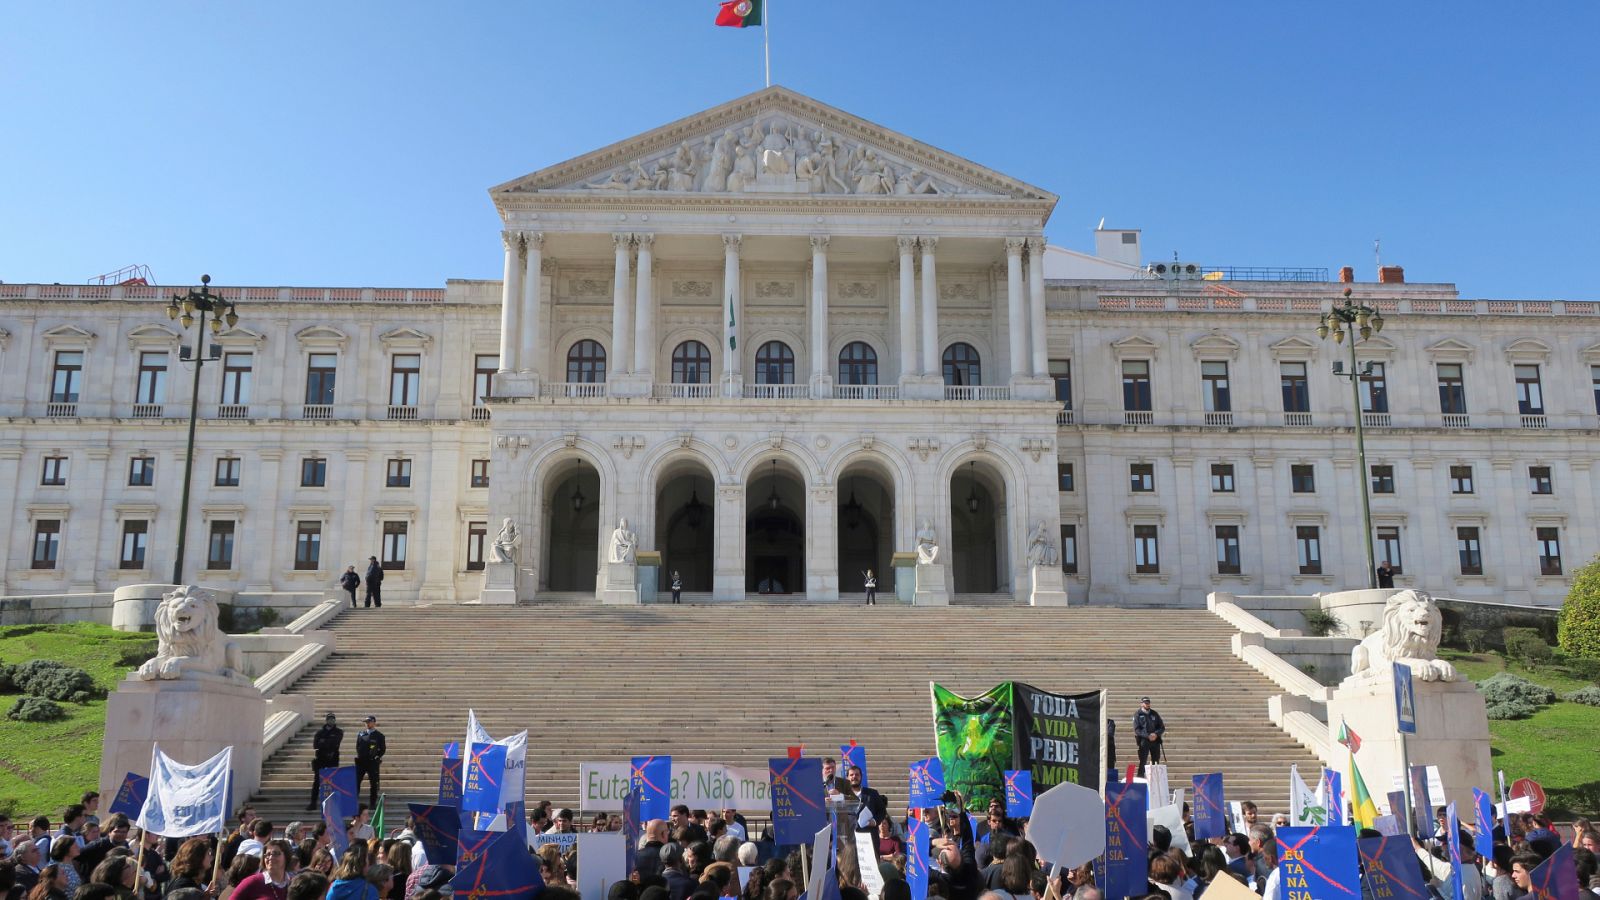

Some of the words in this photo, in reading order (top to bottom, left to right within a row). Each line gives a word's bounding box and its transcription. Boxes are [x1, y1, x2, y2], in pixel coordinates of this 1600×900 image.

[1030, 693, 1079, 718] TODA
[1031, 717, 1042, 734] A
[1045, 719, 1078, 739] VIDA
[1030, 737, 1079, 765] PEDE
[1032, 764, 1079, 785] AMOR
[697, 768, 735, 800] Não
[775, 776, 788, 785] EU
[775, 788, 788, 796] TA
[1109, 807, 1120, 818] EU
[1108, 821, 1119, 832] TA
[1285, 850, 1304, 860] EU
[1285, 864, 1304, 874] TA
[1369, 860, 1384, 871] EU
[1286, 875, 1308, 888] NÁ
[1372, 874, 1388, 885] TA
